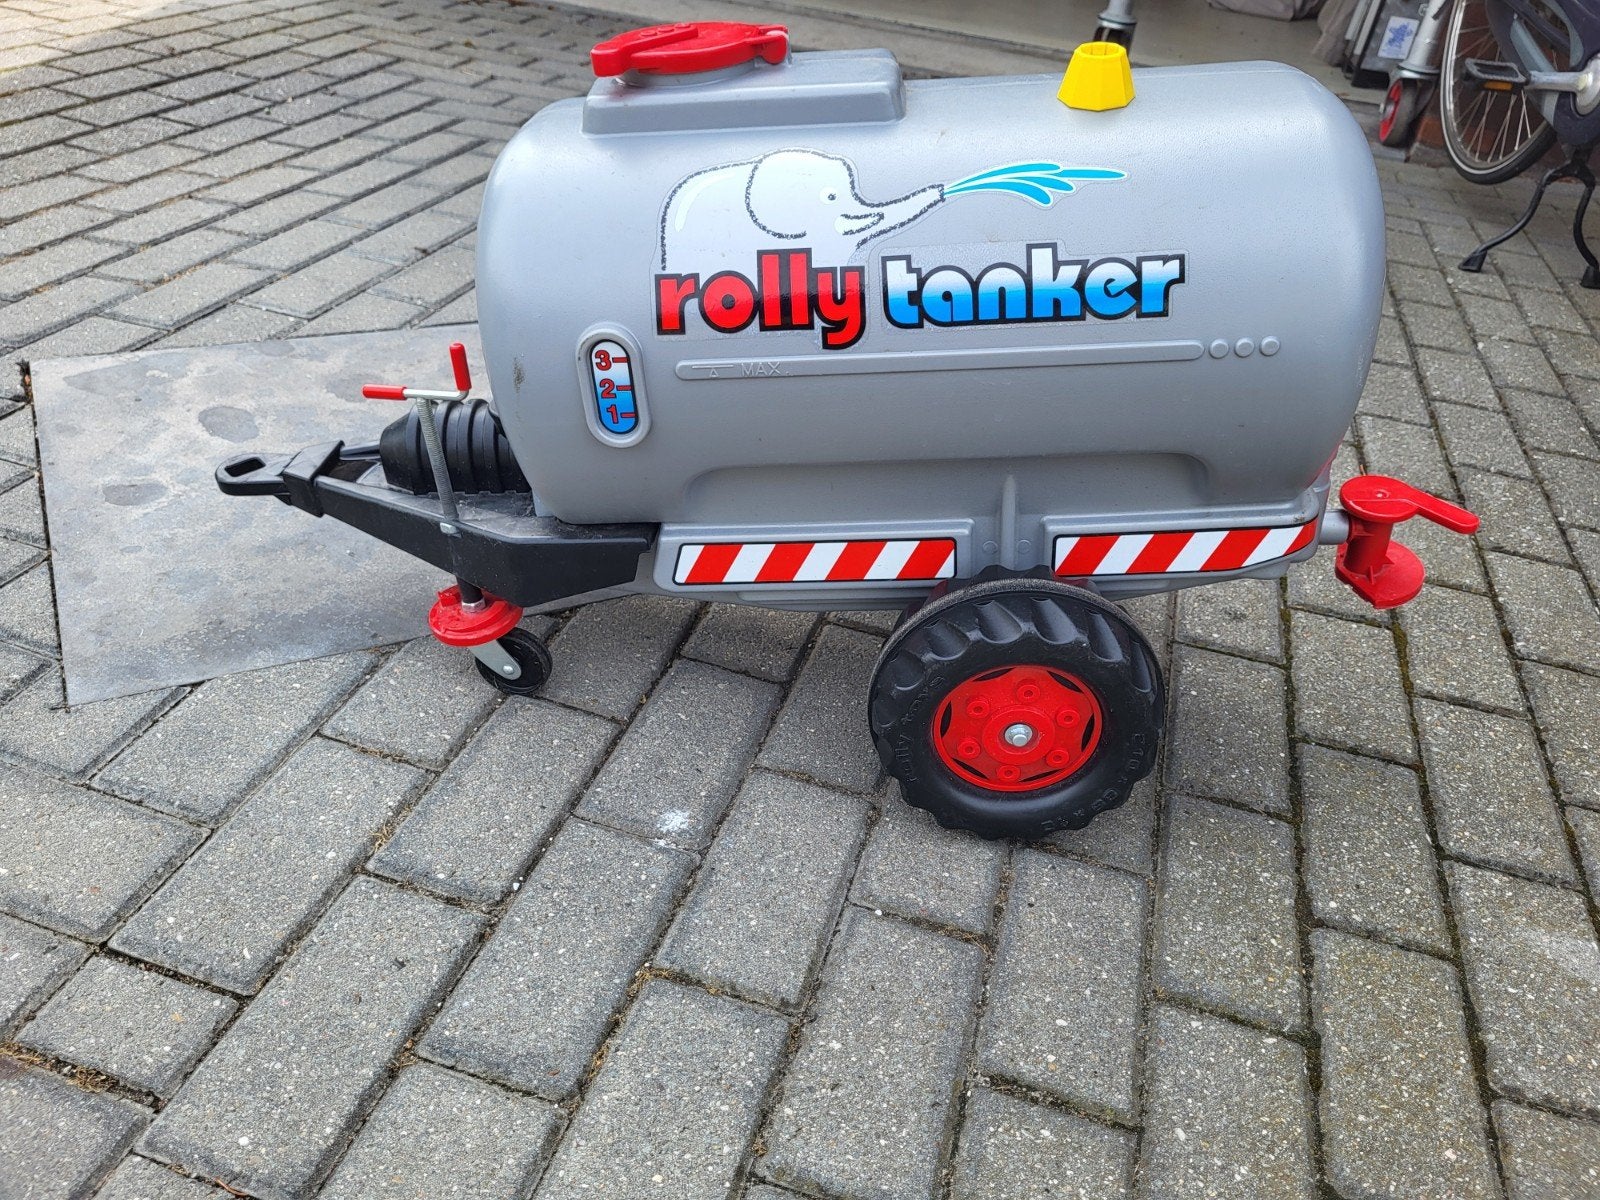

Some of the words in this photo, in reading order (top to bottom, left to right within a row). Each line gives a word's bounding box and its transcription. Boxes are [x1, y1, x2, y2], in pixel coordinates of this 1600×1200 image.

[655, 247, 865, 350] rolly
[882, 242, 1186, 329] tanker
[594, 349, 612, 371] 3
[599, 378, 617, 399] 2
[606, 404, 619, 424] 1
